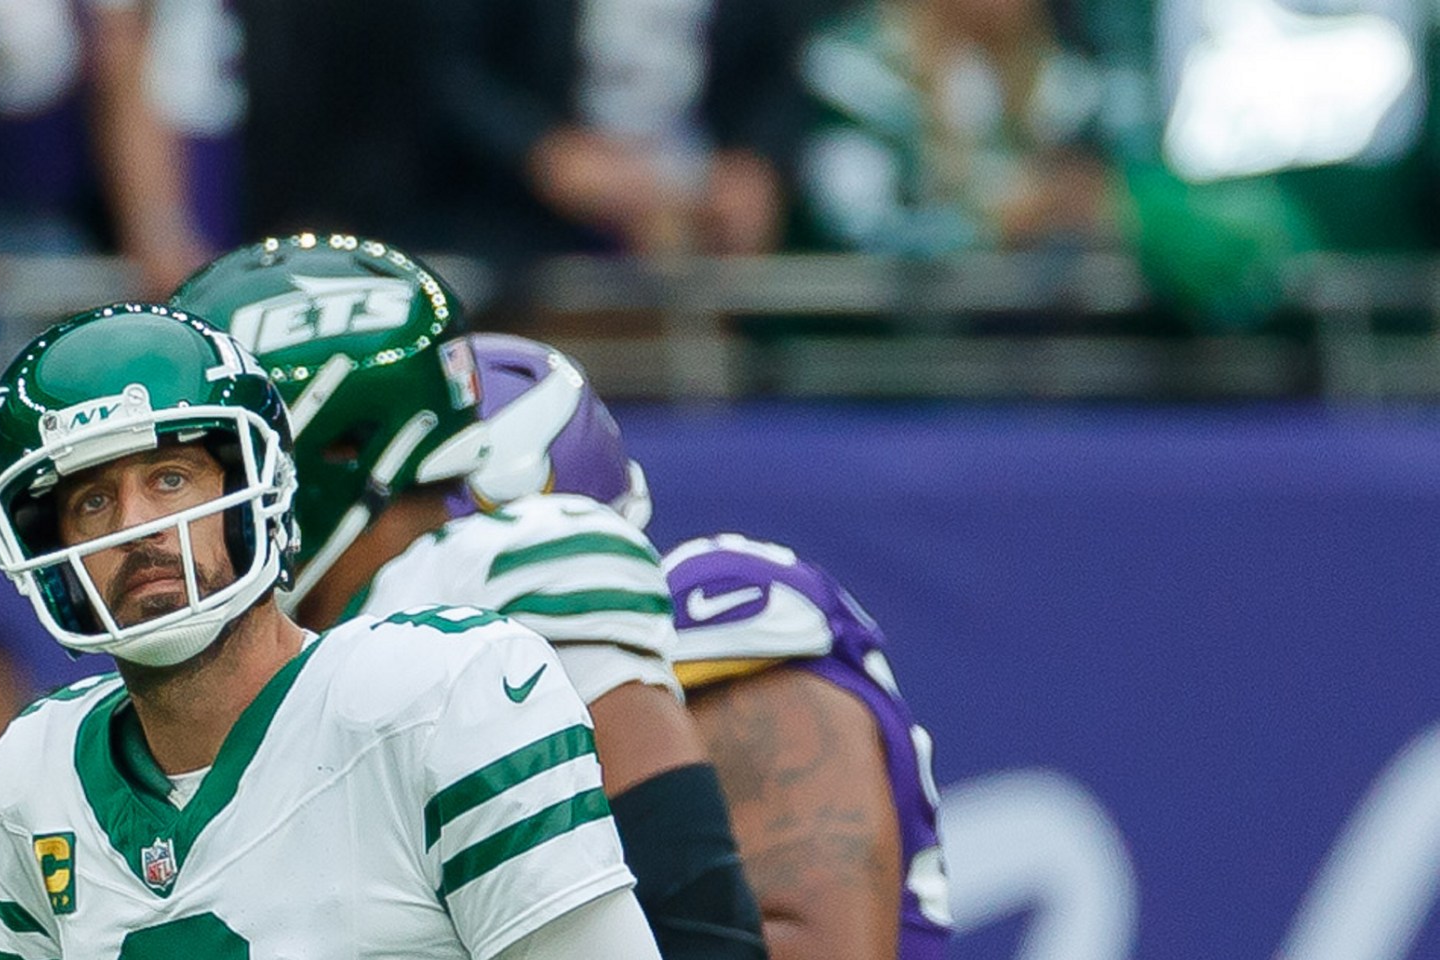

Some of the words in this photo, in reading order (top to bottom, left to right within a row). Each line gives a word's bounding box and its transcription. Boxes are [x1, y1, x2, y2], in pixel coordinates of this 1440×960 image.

[229, 275, 414, 354] JETS
[69, 403, 122, 429] NY
[34, 836, 70, 893] C
